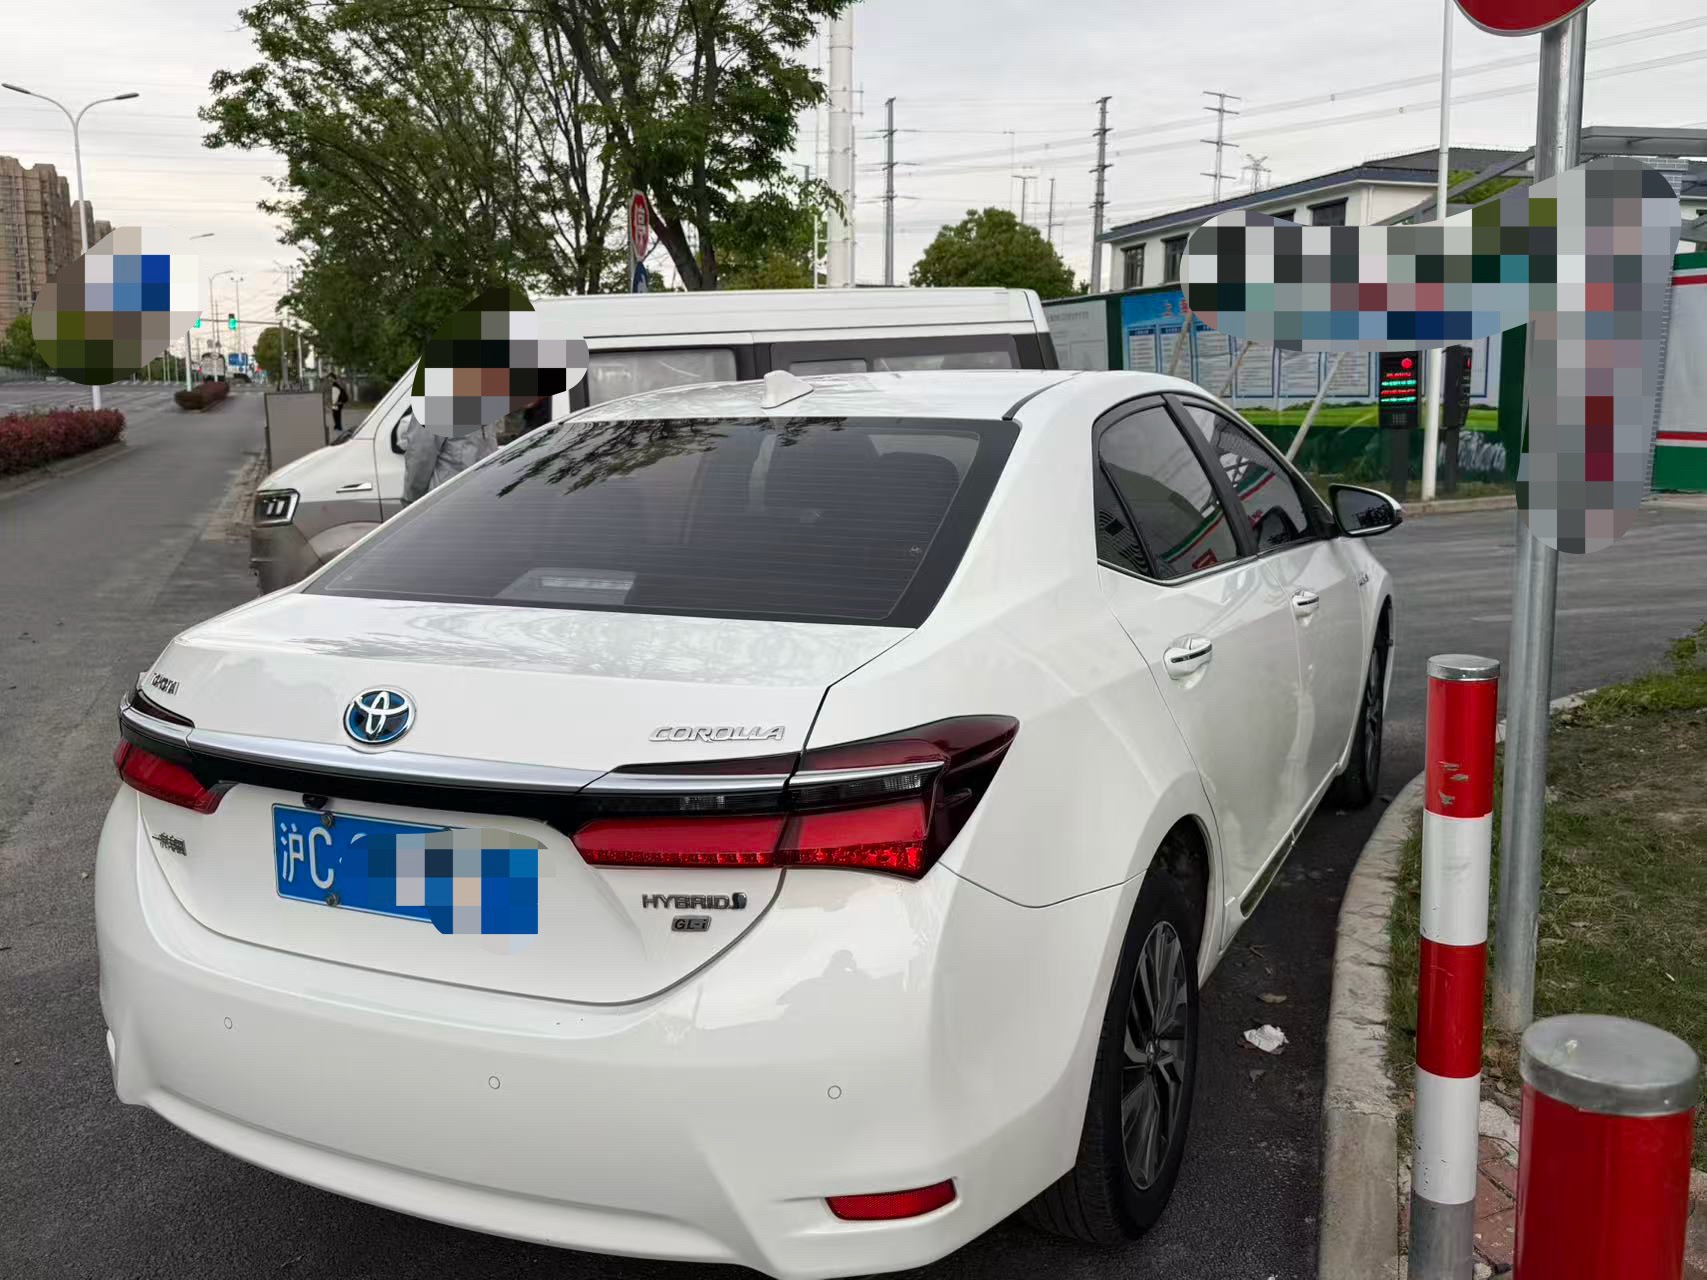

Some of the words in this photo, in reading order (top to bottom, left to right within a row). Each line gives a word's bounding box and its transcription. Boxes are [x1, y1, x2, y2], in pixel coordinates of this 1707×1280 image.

[648, 725, 786, 743] COROLLA
[642, 893, 730, 910] HYBRID
[674, 917, 708, 931] GL-i
